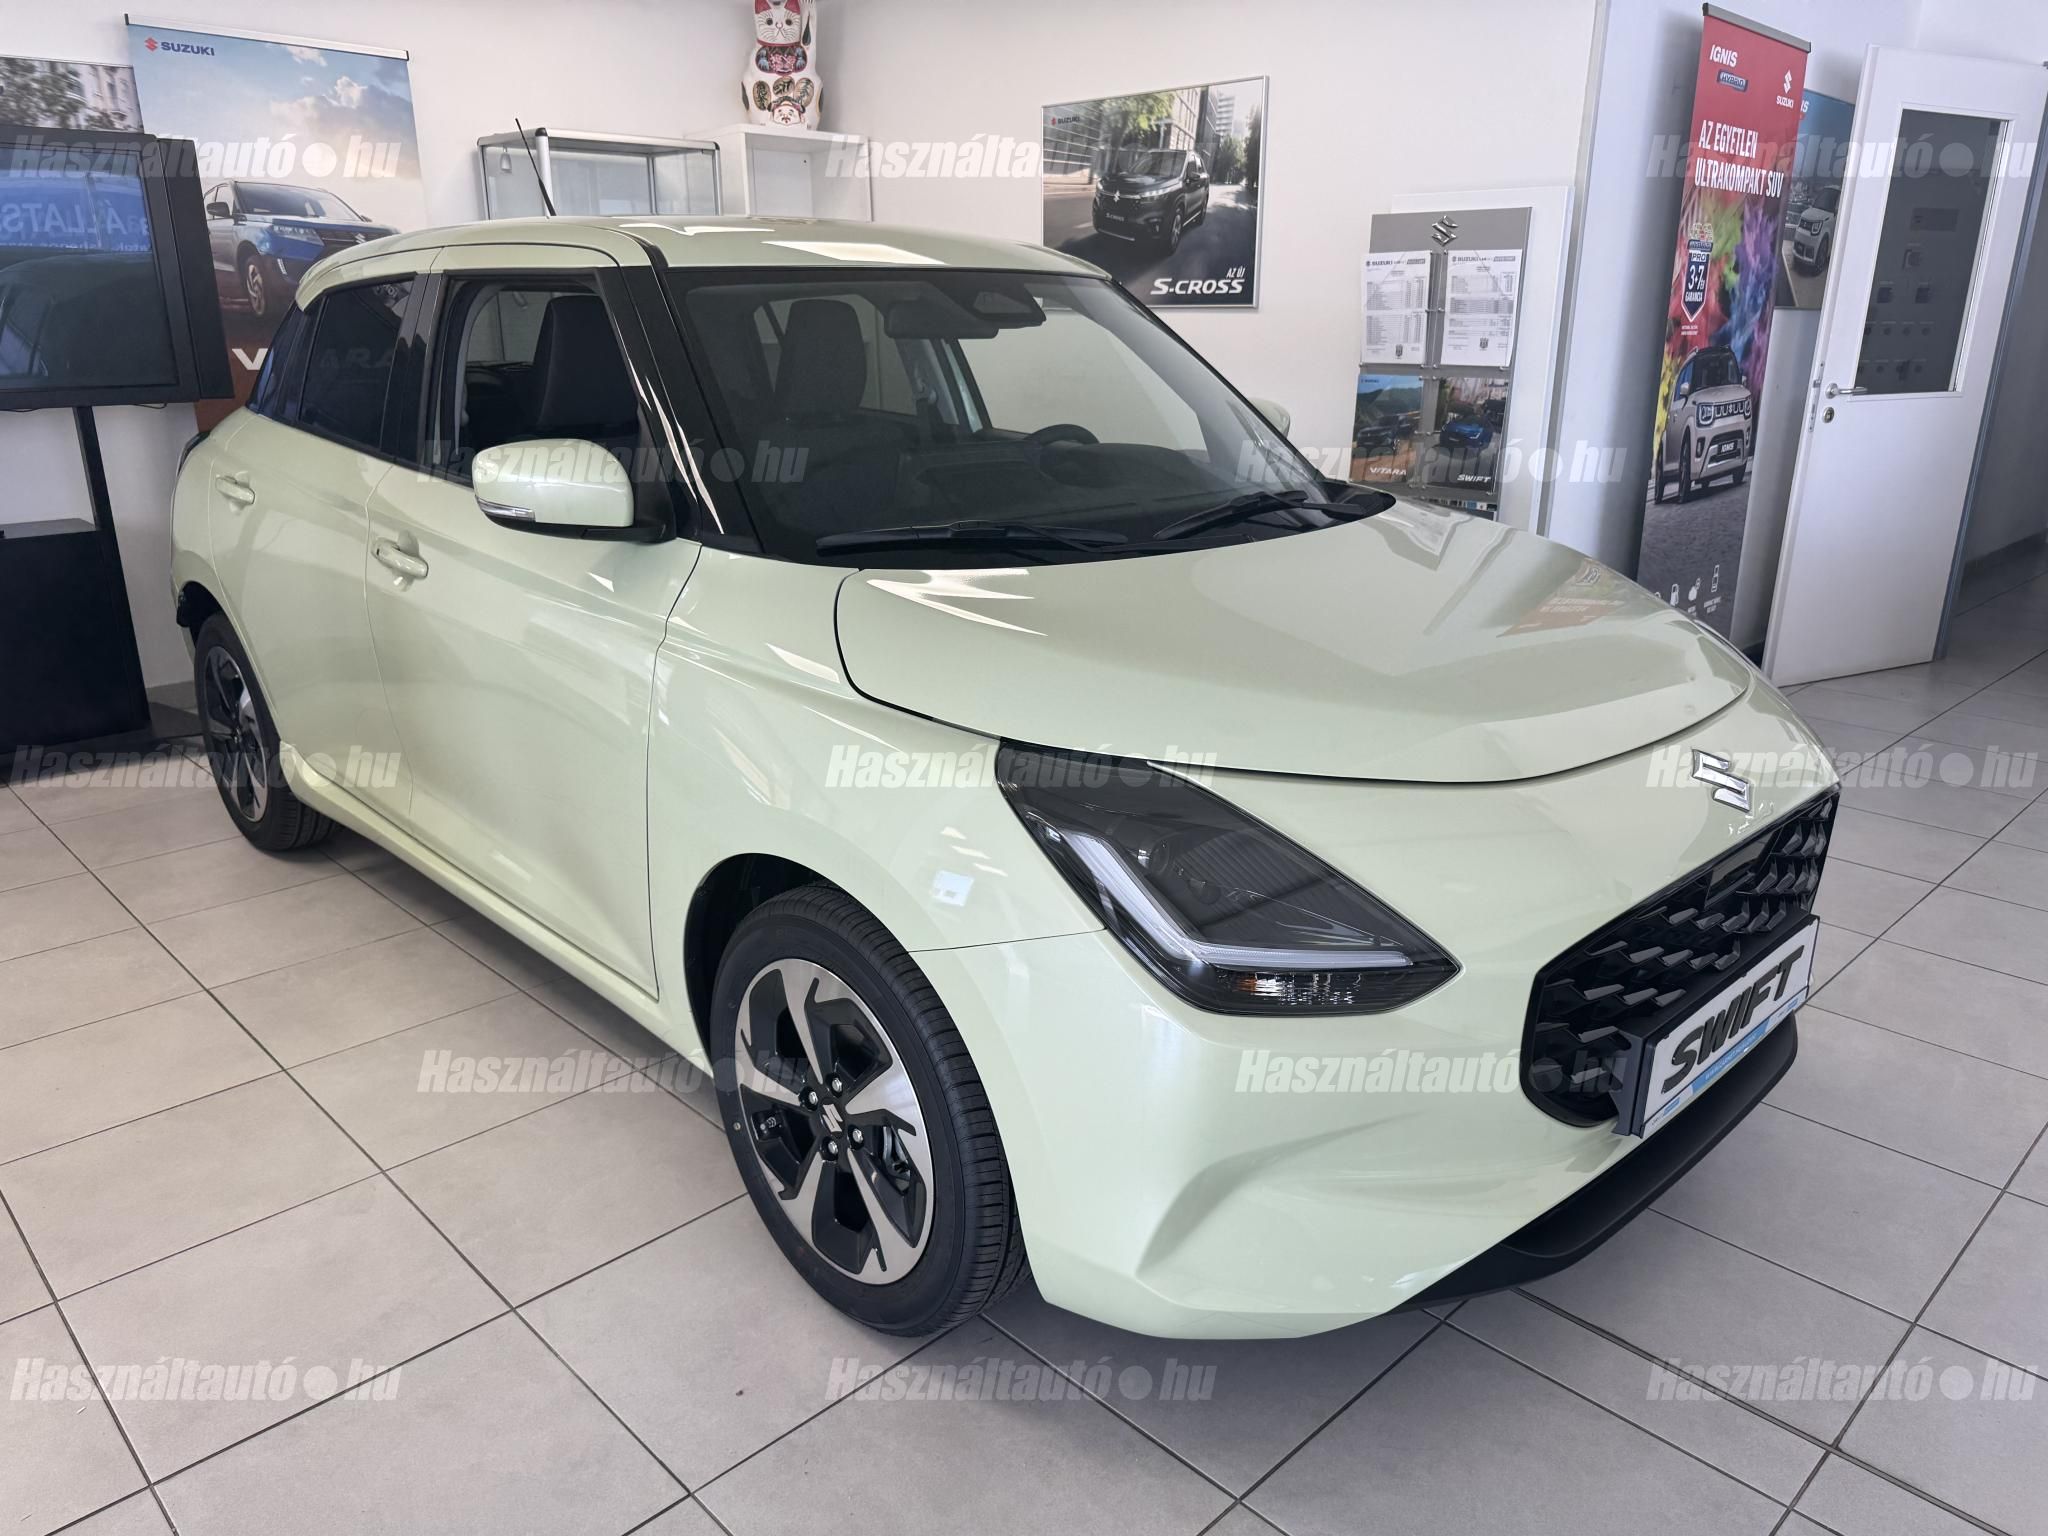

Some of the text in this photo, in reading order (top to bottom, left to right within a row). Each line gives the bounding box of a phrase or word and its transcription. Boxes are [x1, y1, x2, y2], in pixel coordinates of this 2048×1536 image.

[160, 41, 216, 57] SUZUKI
[1709, 44, 1738, 68] IGNIS
[1776, 95, 1795, 109] SUZUKI
[1698, 119, 1759, 159] AZ EGYETLEN
[1695, 157, 1785, 198] ULTRAKOMPAKT SUV
[1226, 267, 1237, 278] AZ
[1150, 278, 1245, 295] S-CROSS
[1369, 466, 1407, 477] VITARA
[1456, 473, 1492, 484] SWIFT
[1661, 944, 1805, 1095] SWIFT
